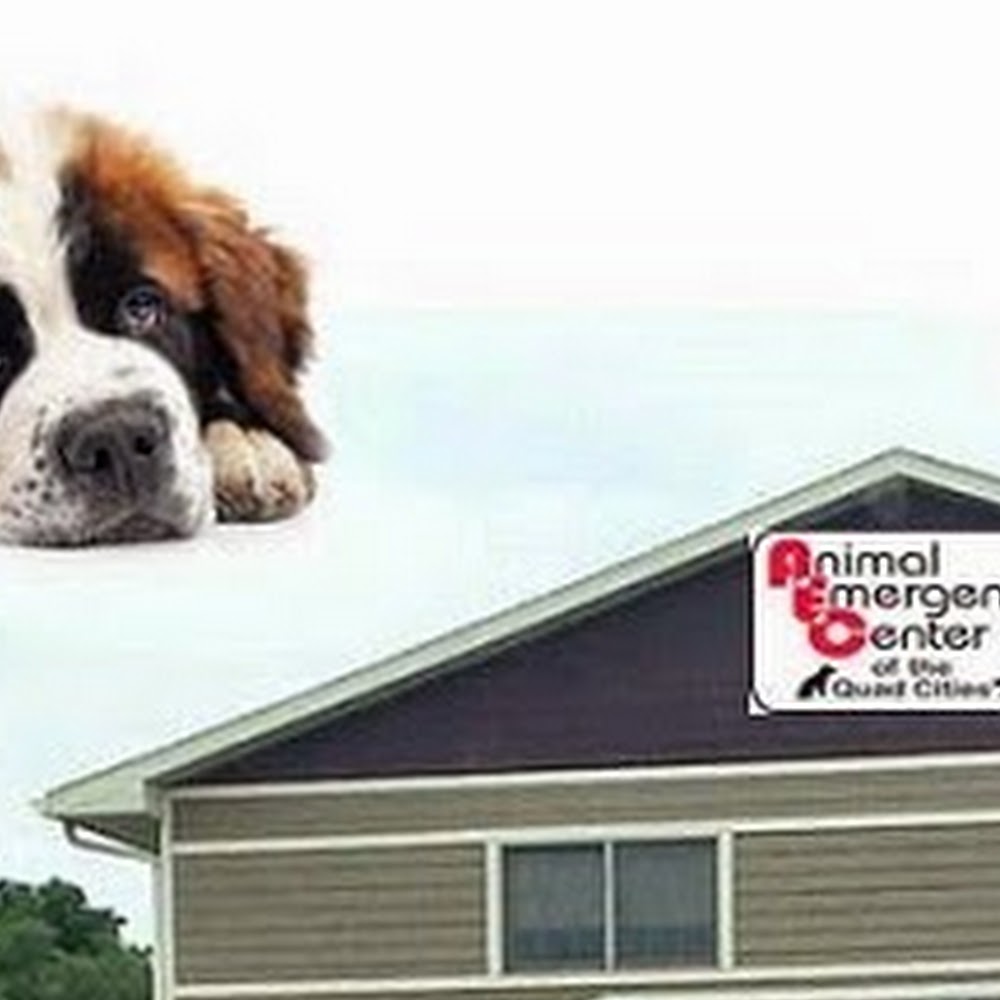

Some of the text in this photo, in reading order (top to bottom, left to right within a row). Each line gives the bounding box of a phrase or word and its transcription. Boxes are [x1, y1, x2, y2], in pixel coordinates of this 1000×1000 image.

[768, 538, 940, 587] Animal
[809, 609, 989, 658] Center
[871, 658, 953, 677] of the
[832, 677, 992, 698] Quad Cities
